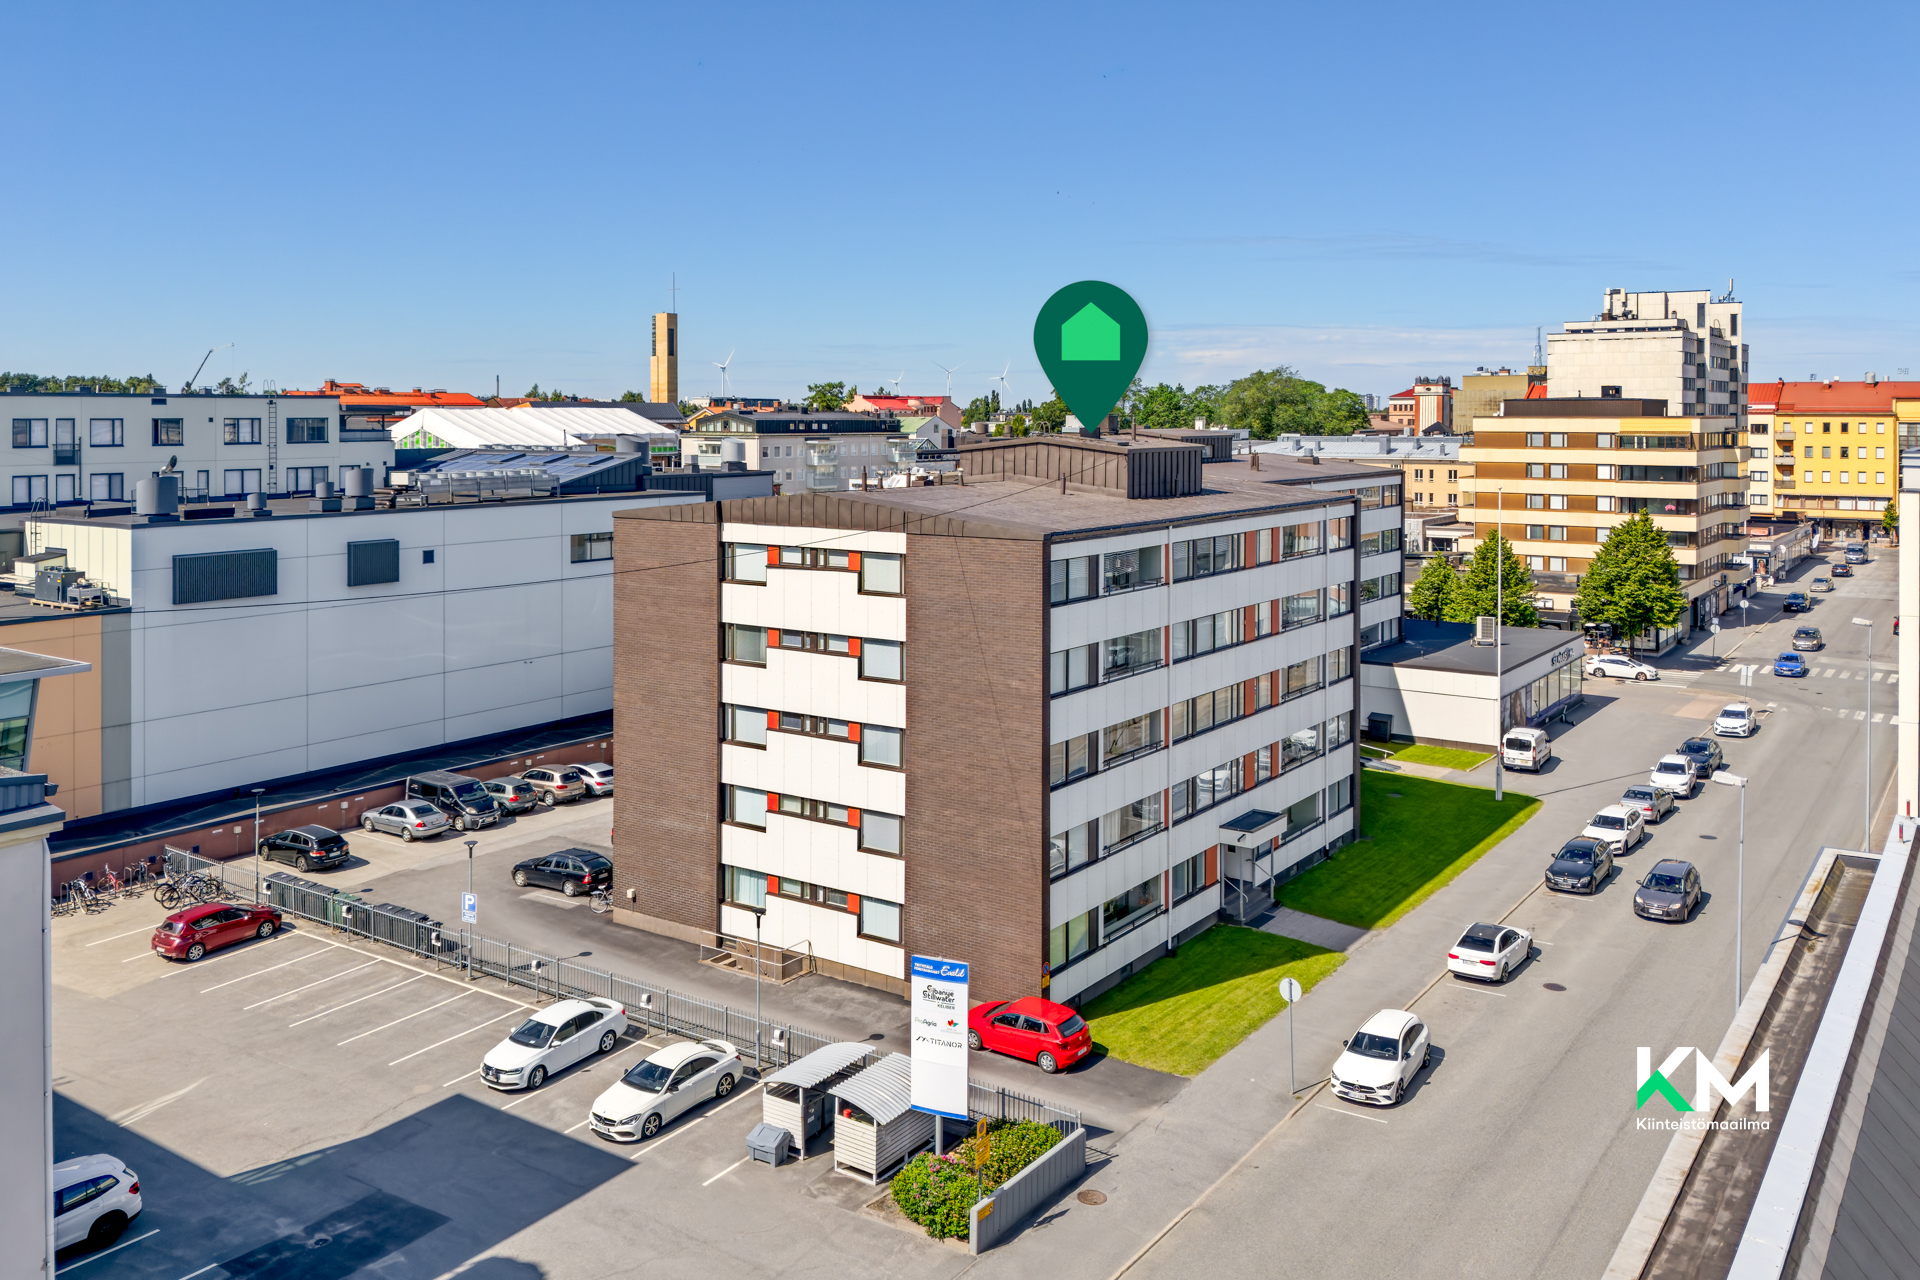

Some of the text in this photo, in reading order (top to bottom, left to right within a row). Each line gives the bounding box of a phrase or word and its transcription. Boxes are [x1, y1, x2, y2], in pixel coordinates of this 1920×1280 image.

[465, 895, 475, 910] P
[923, 990, 955, 1003] Stillwater
[930, 1038, 962, 1049] TITANOR
